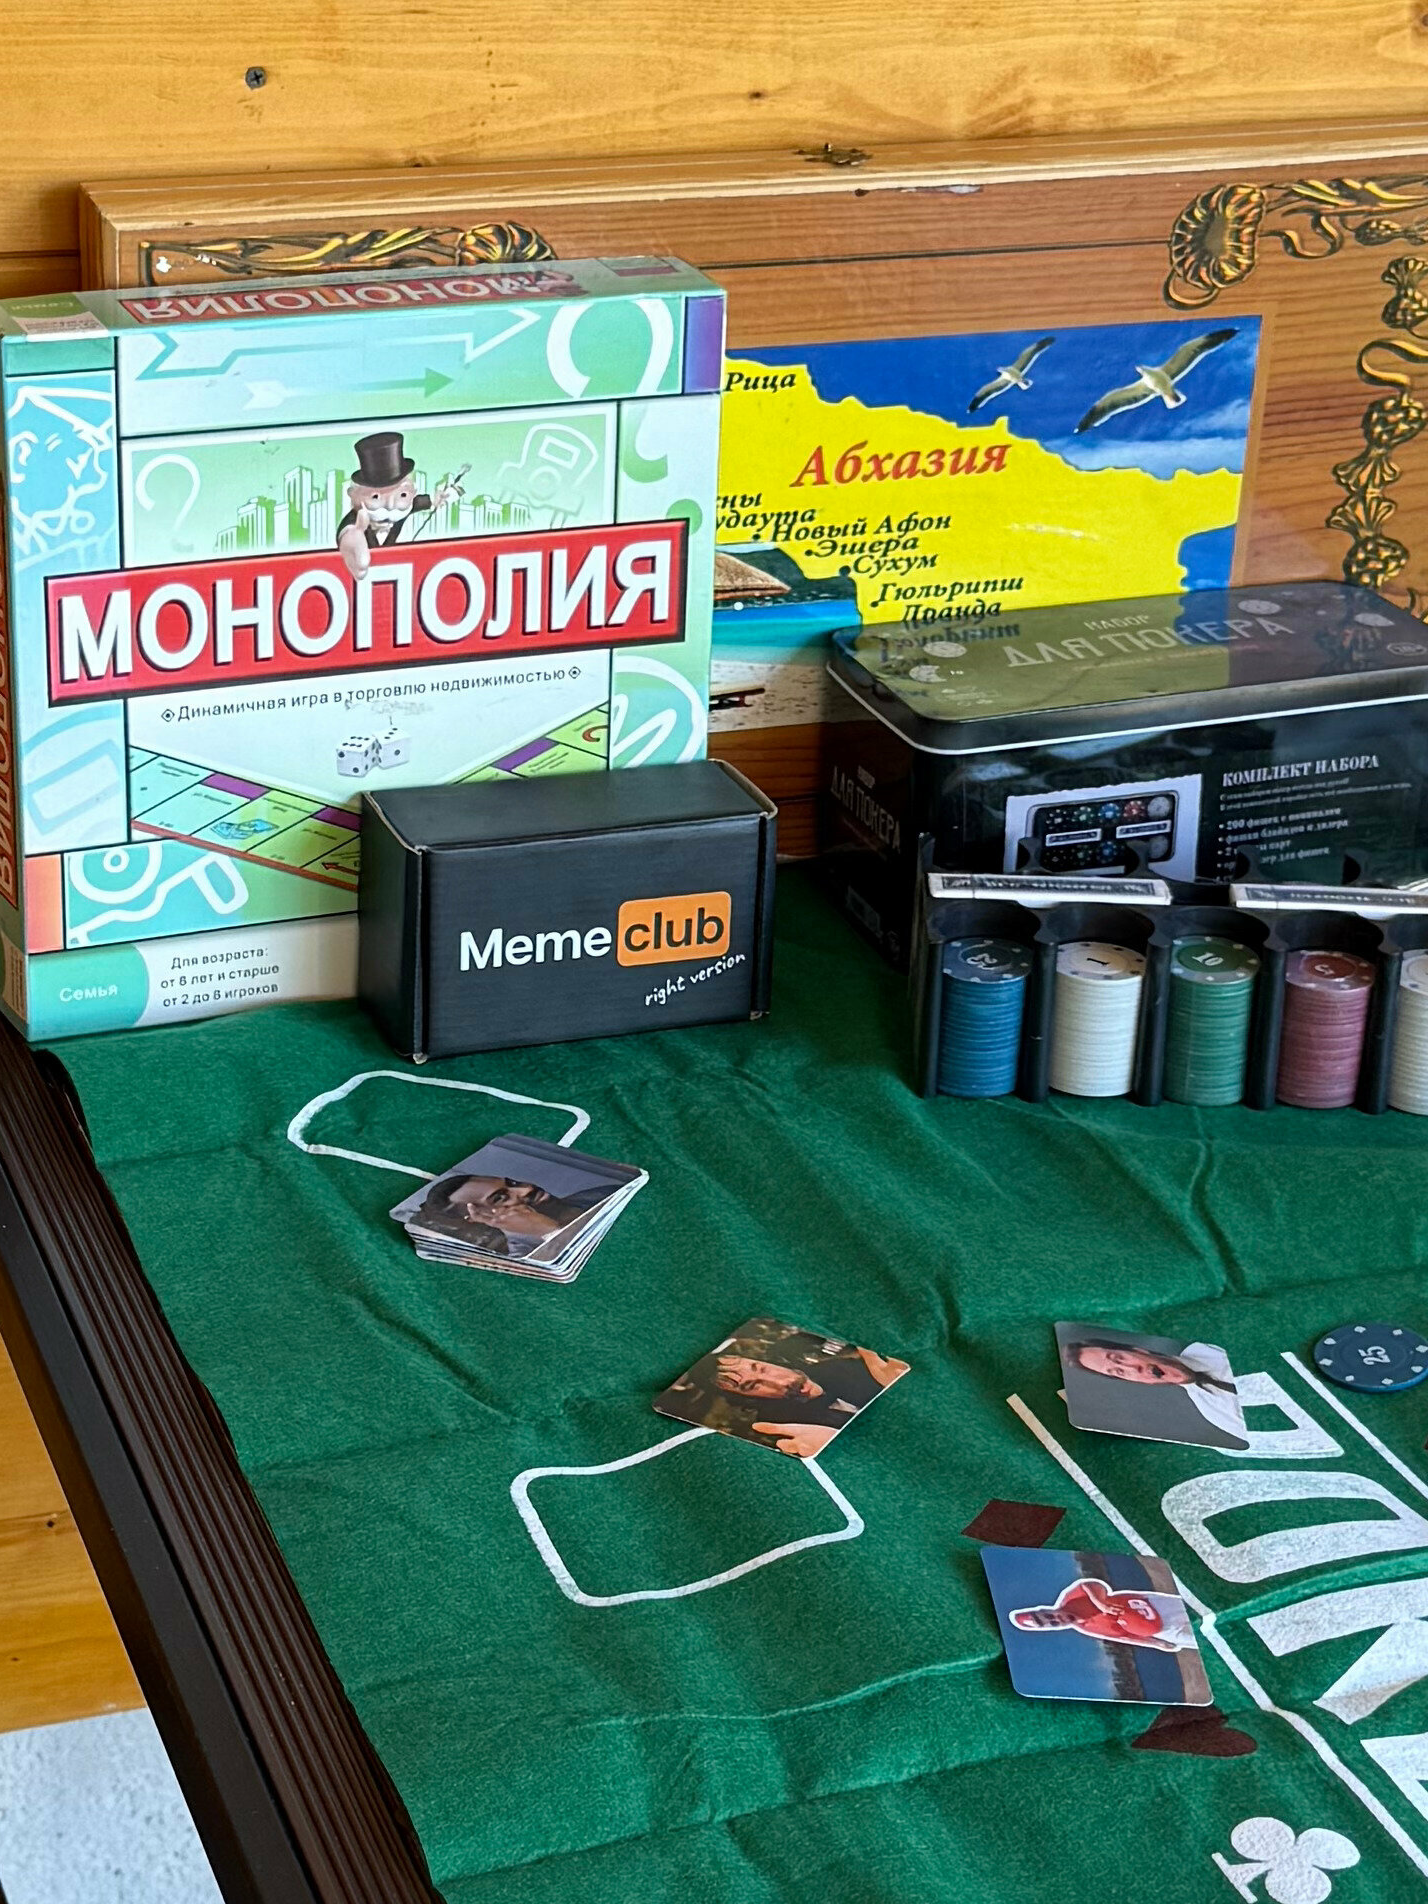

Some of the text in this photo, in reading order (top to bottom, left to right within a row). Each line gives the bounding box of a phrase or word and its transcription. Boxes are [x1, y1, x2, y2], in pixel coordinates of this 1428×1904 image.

[725, 372, 797, 394] Рица
[789, 440, 1013, 488] Абхазия
[716, 493, 763, 509] ны
[772, 511, 951, 543] Новый Афон
[813, 537, 920, 557] Эшера
[852, 554, 939, 579] Сухум
[877, 577, 1024, 604] Гюльрипш
[58, 540, 671, 684] МОНОПОЛИЯ
[1084, 615, 1150, 631] НАБОР
[1003, 637, 1104, 668] ДЛЯ
[1100, 617, 1296, 654] ПОКЕРА
[177, 667, 566, 722] Динамичная игра в торговлю недвижимостью
[1222, 754, 1380, 787] КОМПЛЕКТ НАБОРА
[459, 907, 725, 972] Meme club
[1192, 951, 1224, 967] 10
[160, 978, 175, 989] от
[218, 972, 226, 981] и
[645, 953, 747, 1006] right version
[59, 982, 118, 1003] Семья
[163, 997, 178, 1008] от
[181, 994, 189, 1005] 2
[192, 991, 211, 1006] до
[1357, 1344, 1391, 1366] 25
